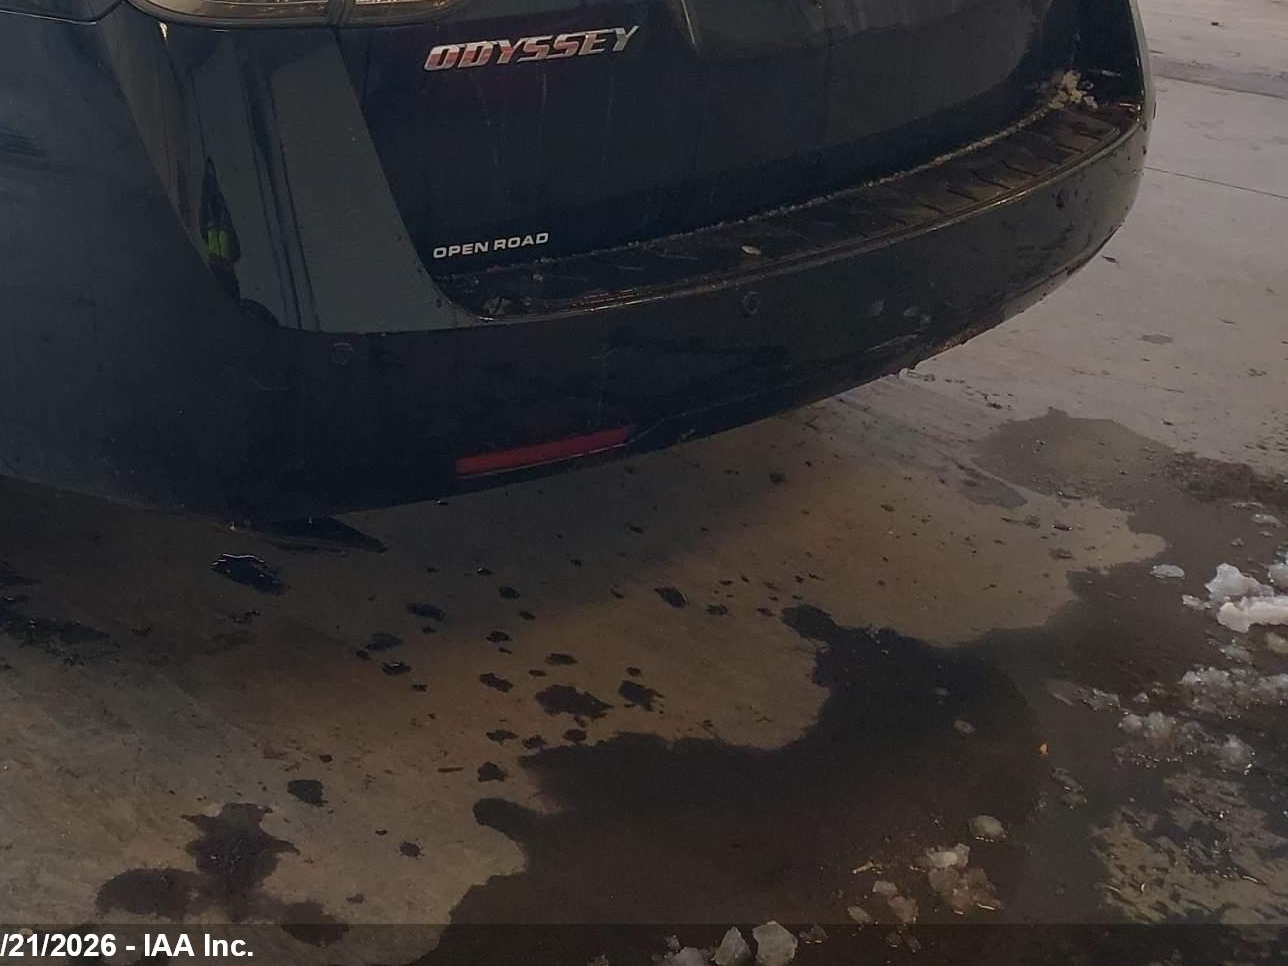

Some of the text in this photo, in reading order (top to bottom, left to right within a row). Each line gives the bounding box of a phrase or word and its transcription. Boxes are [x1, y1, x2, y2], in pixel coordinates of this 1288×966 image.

[423, 25, 640, 72] ODYSSEY
[433, 233, 549, 259] OPEN ROAD
